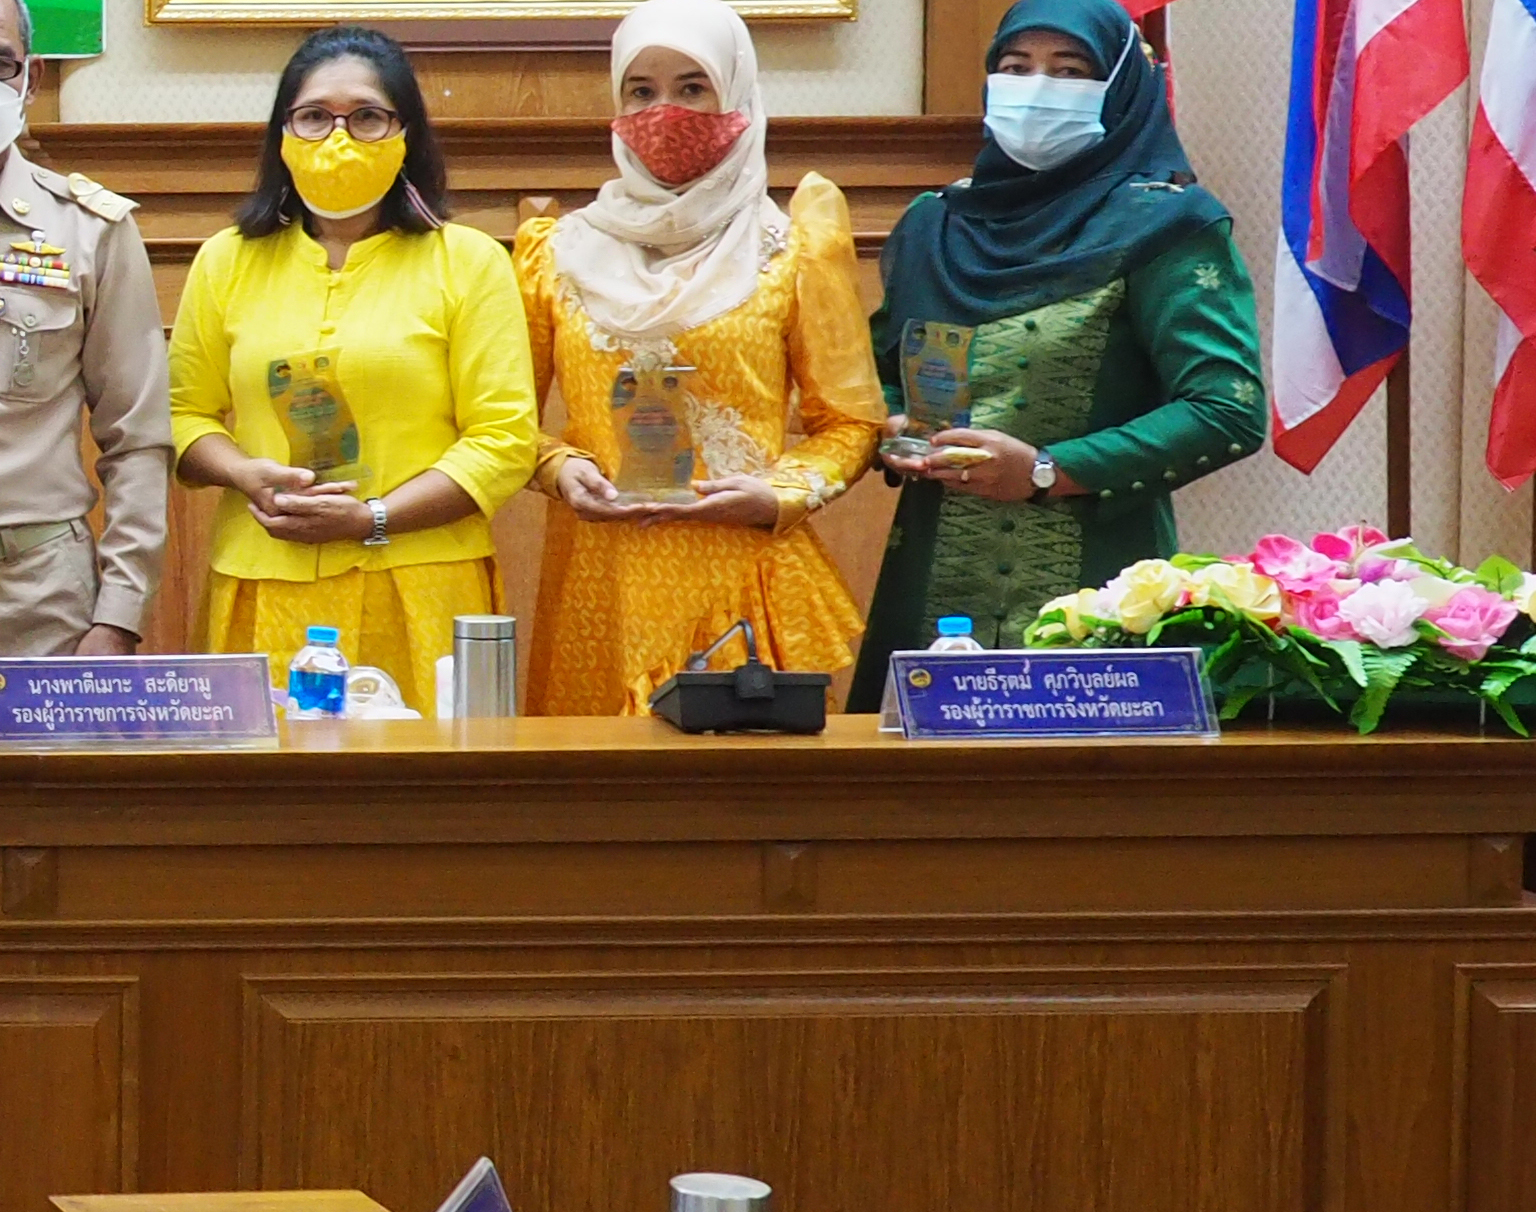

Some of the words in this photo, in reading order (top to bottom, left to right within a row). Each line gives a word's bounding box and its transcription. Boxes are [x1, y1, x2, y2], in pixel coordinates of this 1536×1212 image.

[12, 699, 234, 730] รองผู้ว่าราชการจังหวัดยะลา
[940, 695, 1164, 727] รองผู้ว่าราชการจังหวัดยะลา
